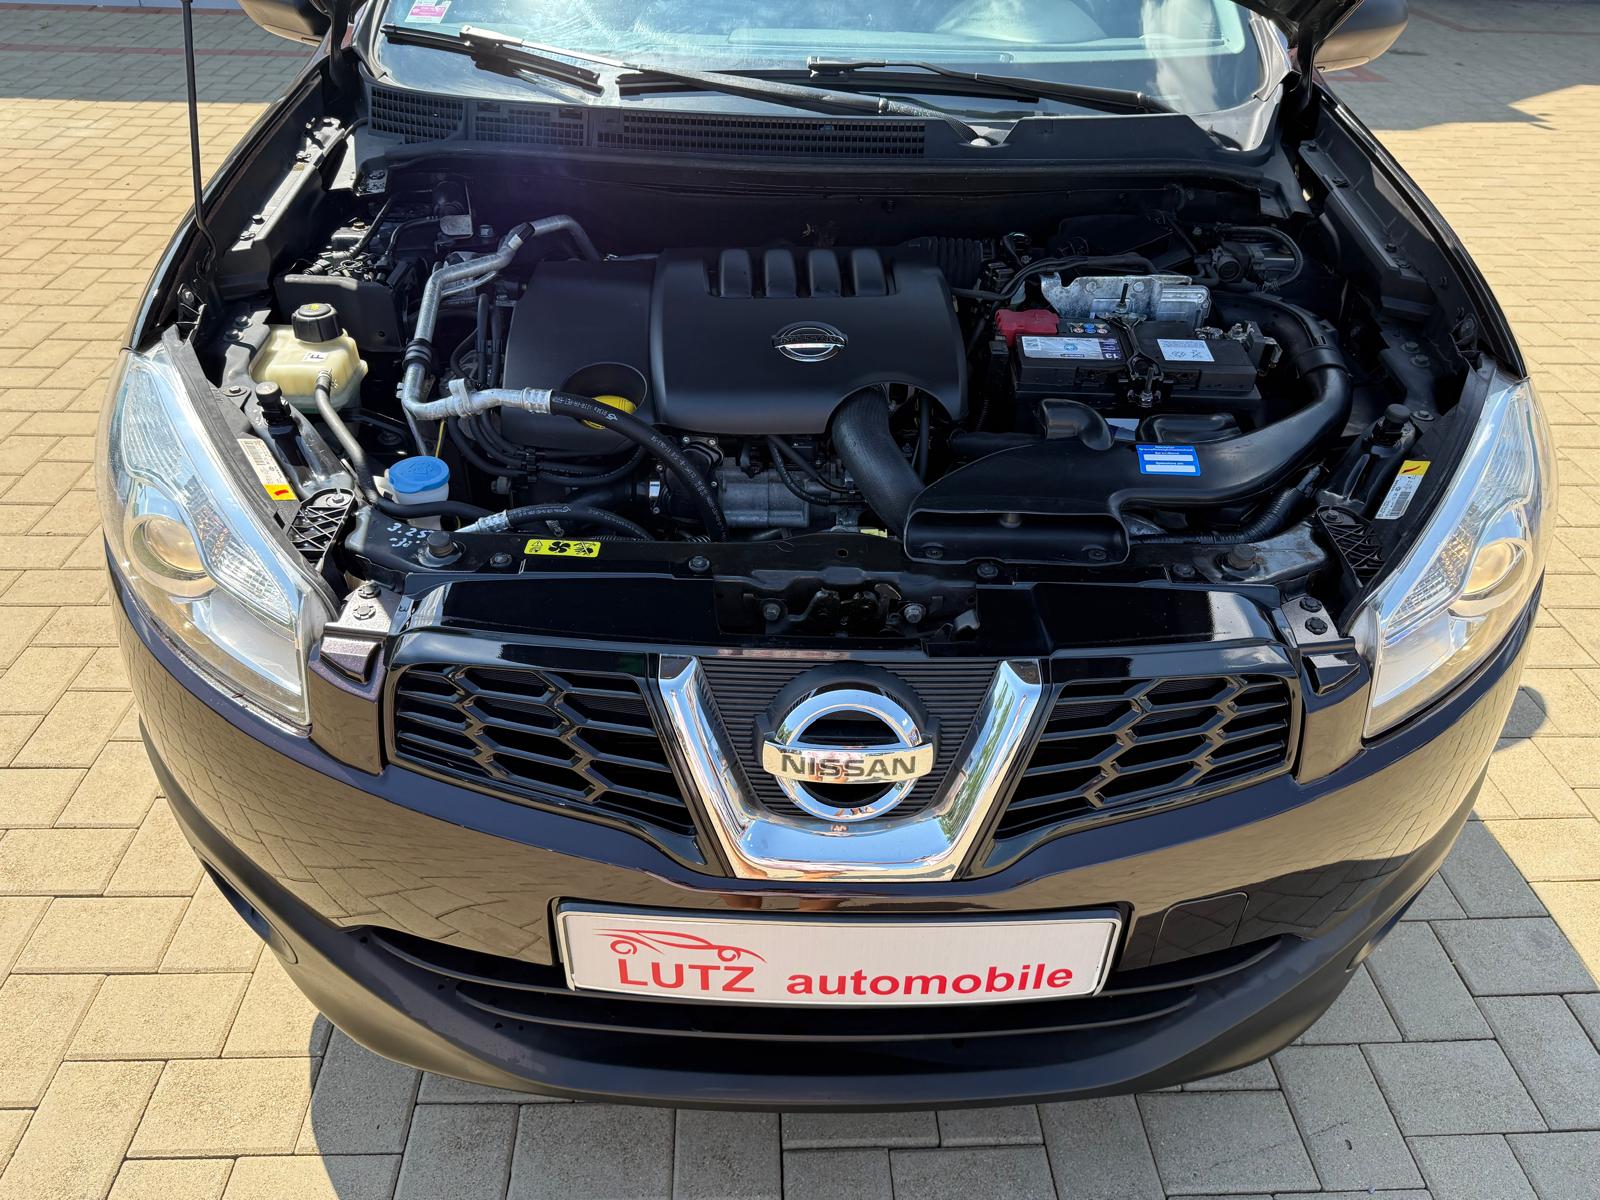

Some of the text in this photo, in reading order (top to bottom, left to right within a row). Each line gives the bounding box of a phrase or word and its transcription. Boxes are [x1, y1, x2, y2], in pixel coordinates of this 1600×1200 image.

[781, 754, 916, 778] NISSAN
[617, 957, 1074, 997] LUTZ automobile
